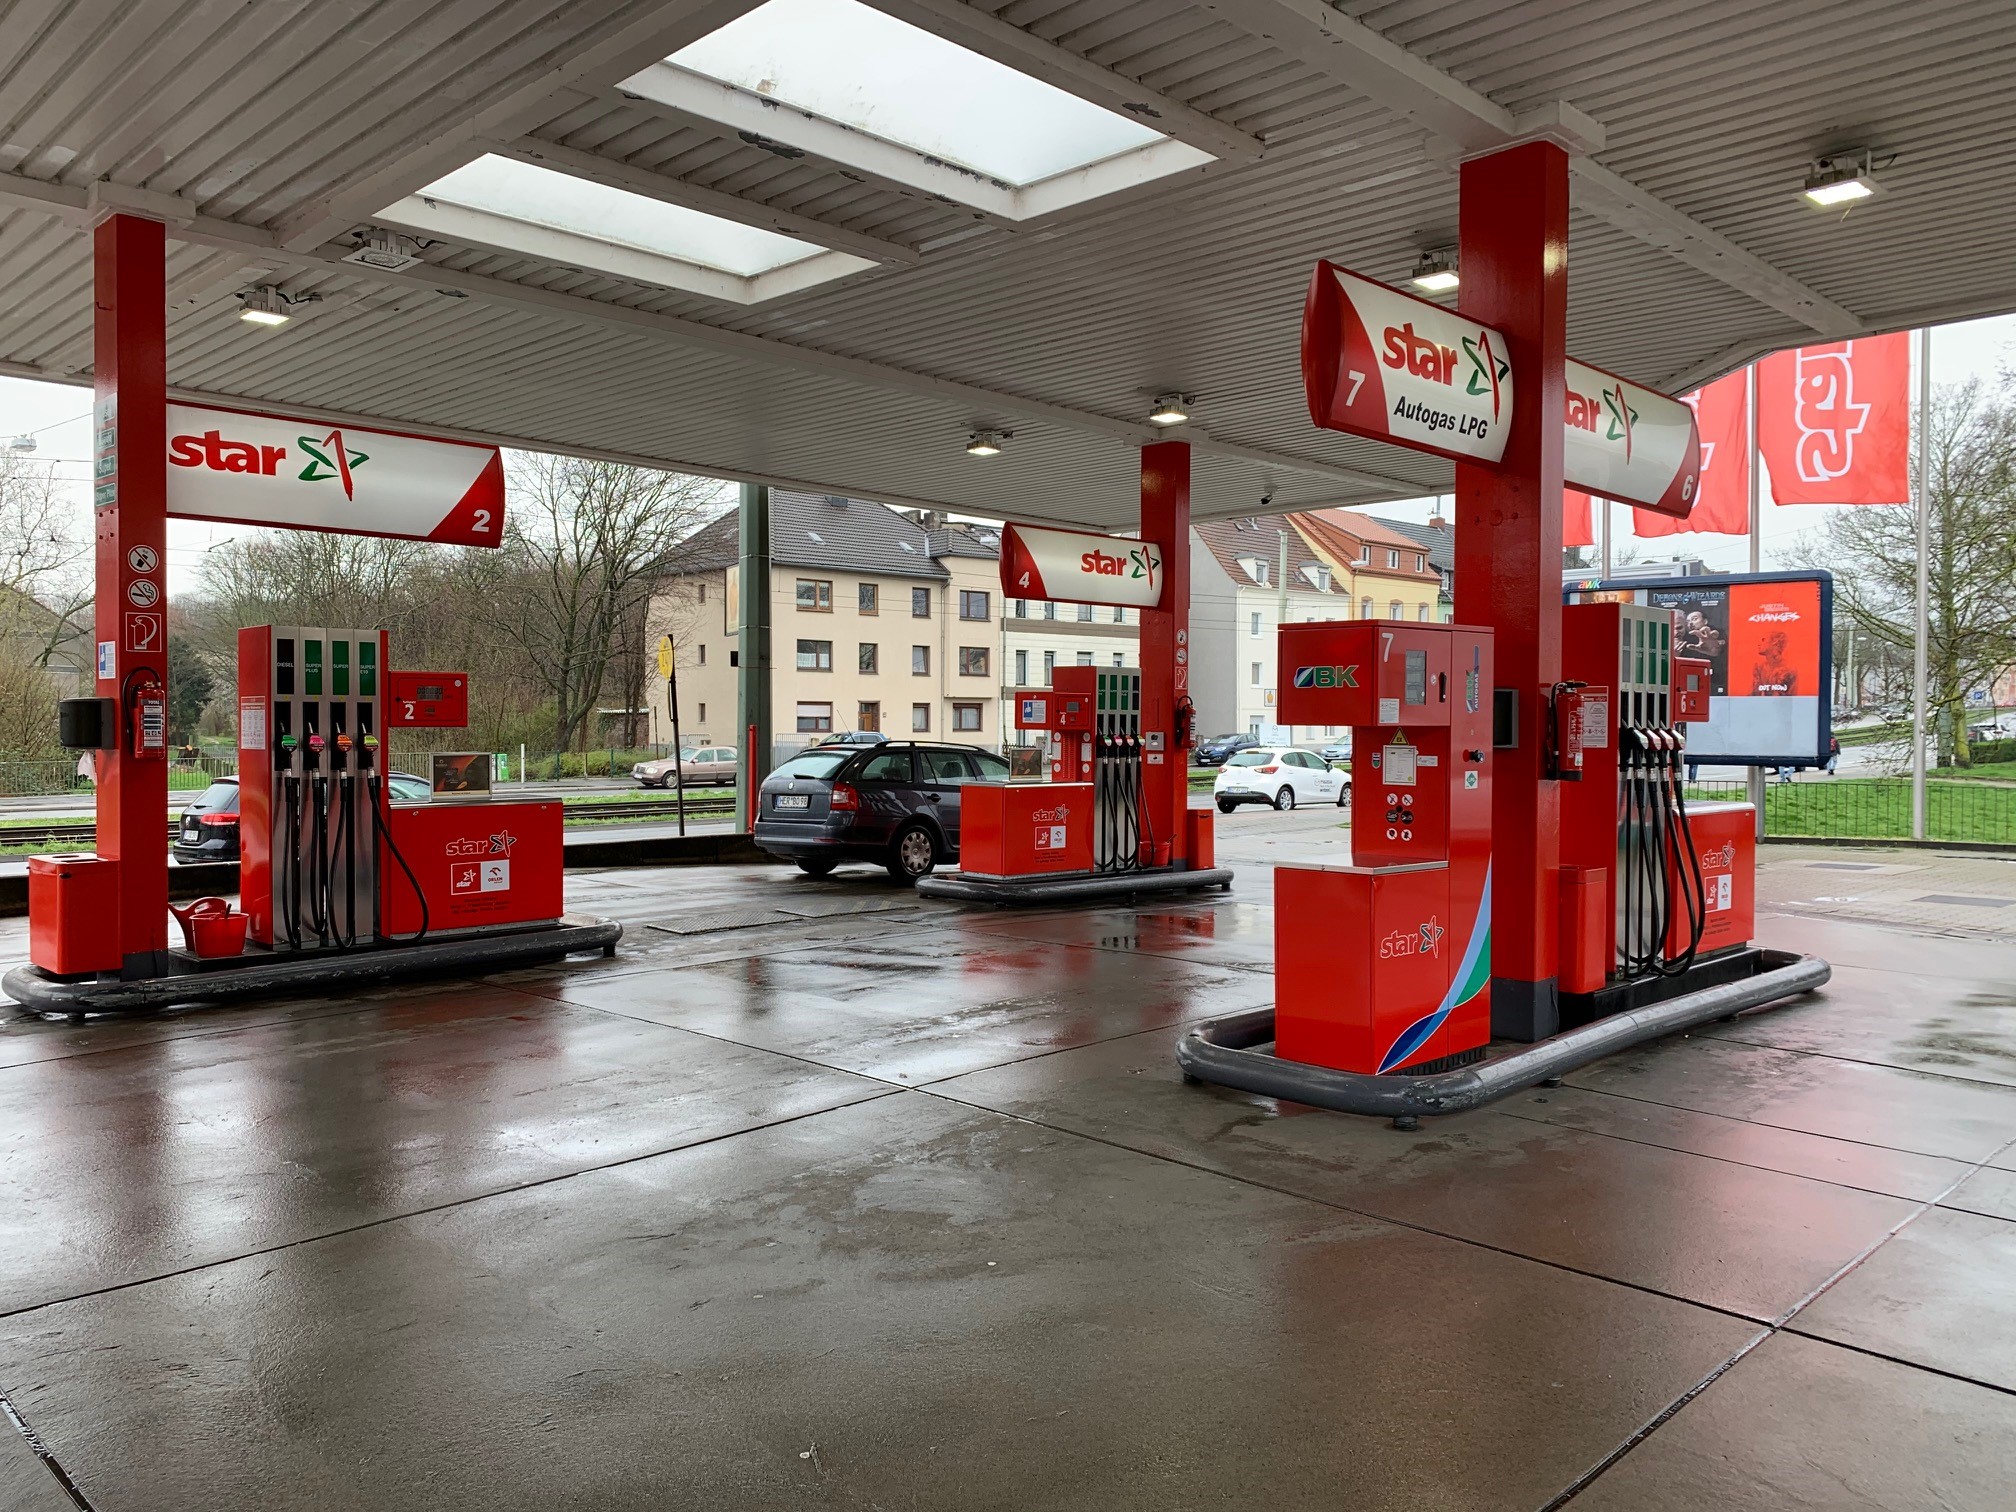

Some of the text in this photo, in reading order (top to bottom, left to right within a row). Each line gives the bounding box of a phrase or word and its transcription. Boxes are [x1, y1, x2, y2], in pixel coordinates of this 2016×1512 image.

[1383, 323, 1458, 386] star
[1345, 370, 1366, 407] 7
[1393, 395, 1488, 439] Autogas LPG
[1564, 378, 1600, 433] tar
[169, 430, 286, 476] star
[1681, 475, 1693, 501] 6
[471, 510, 491, 532] 2
[1081, 549, 1127, 576] star
[1018, 571, 1030, 588] 4
[1578, 578, 1601, 589] awk
[1382, 633, 1394, 662] 7
[404, 704, 415, 720] 2
[1681, 694, 1687, 713] 6
[1060, 714, 1066, 725] 4
[1033, 808, 1055, 821] star
[446, 838, 488, 856] star
[1702, 849, 1722, 869] star
[1380, 930, 1418, 959] star
